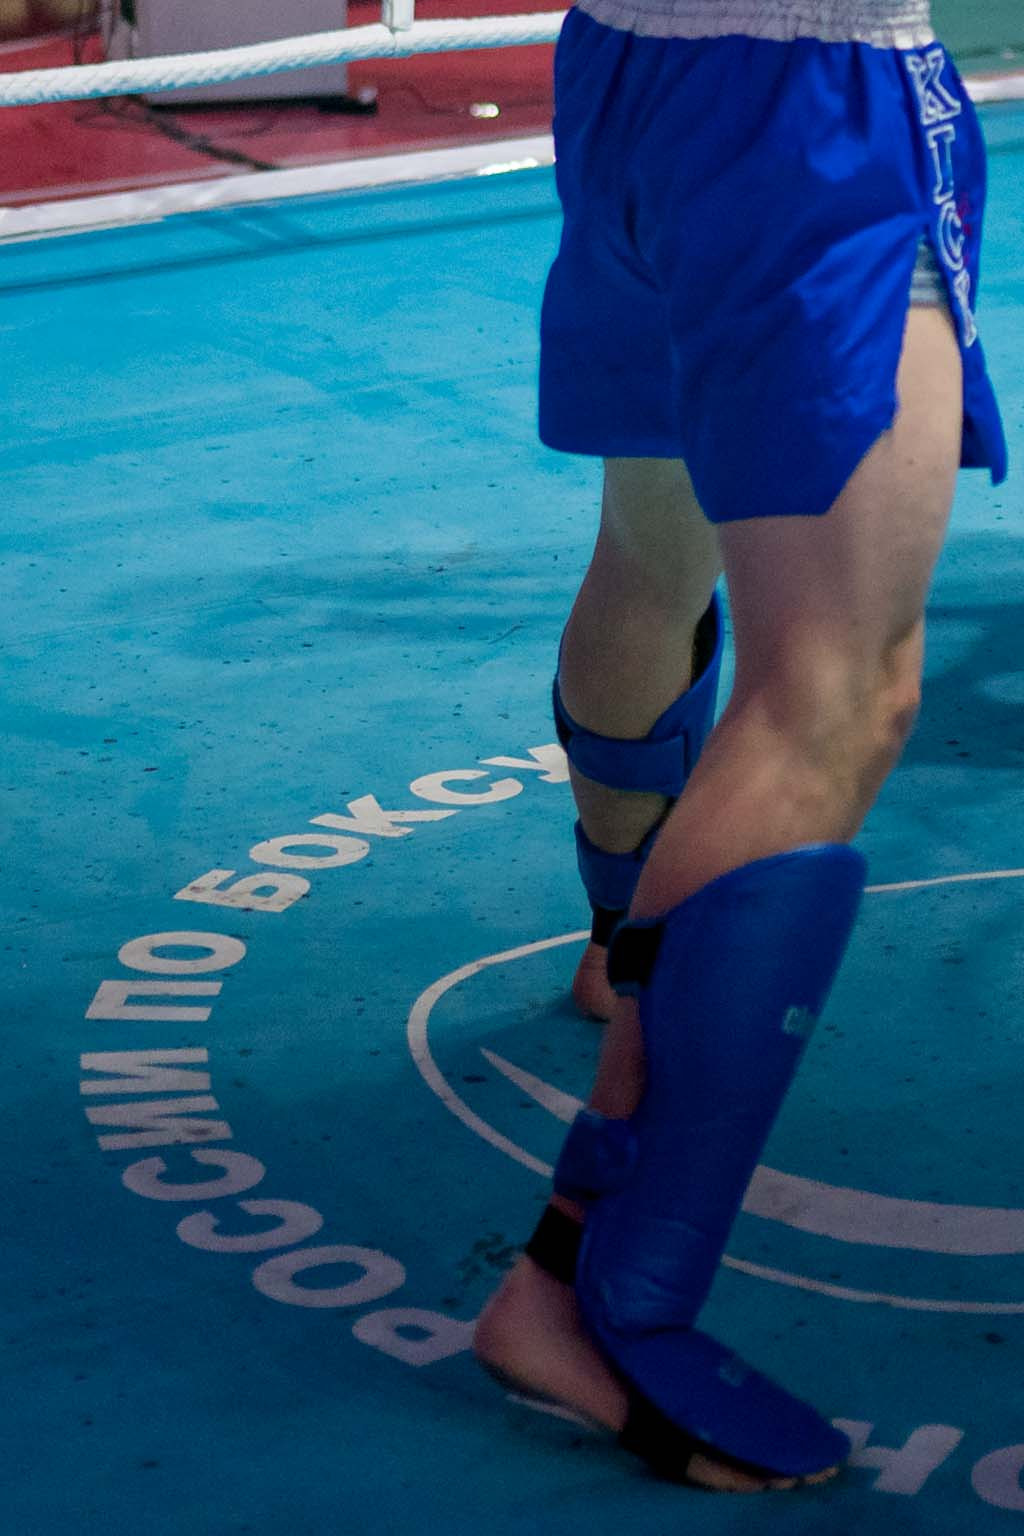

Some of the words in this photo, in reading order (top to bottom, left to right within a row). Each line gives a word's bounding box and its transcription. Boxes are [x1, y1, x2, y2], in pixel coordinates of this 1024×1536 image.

[174, 743, 571, 912] БОКСУ
[85, 931, 246, 1021] ПО
[80, 1048, 477, 1366] РОССИИ
